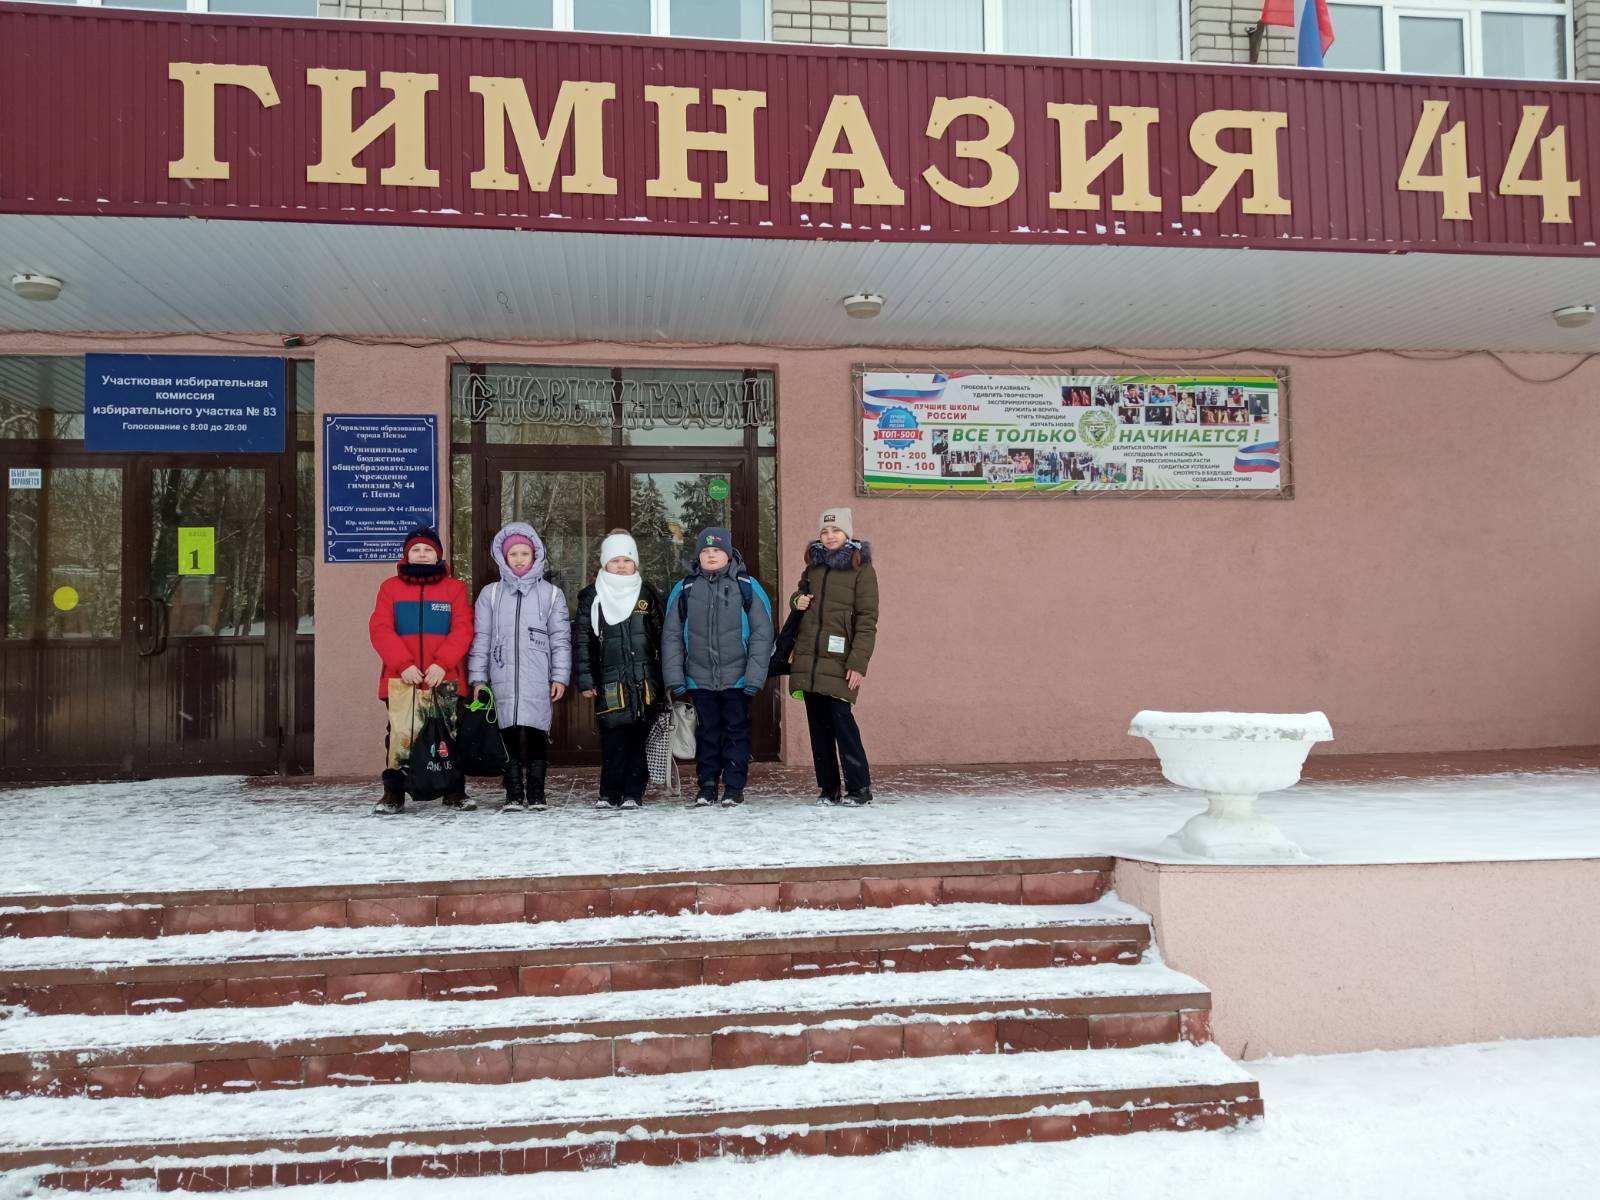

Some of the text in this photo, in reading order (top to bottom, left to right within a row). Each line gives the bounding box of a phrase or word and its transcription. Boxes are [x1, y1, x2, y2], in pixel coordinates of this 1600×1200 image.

[168, 61, 1582, 224] ГИМНАЗИЯ 44
[101, 375, 268, 388] Участковая избирательная
[155, 391, 215, 400] комиссия
[92, 405, 277, 418] избирательного участка № 83
[927, 412, 968, 420] РОССИИ
[122, 422, 181, 431] Голосование
[190, 423, 209, 431] 8:00
[224, 424, 248, 432] 20:00
[335, 424, 379, 432] Управление
[881, 430, 916, 438] ТОП-500
[952, 429, 1077, 443] ВСЕ ТОЛЬКО
[1119, 429, 1249, 443] НАЧИНАЕТСЯ
[344, 446, 418, 455] Муниципальное
[356, 455, 406, 463] бюджетное
[908, 452, 927, 460] 200
[332, 464, 429, 472] общеобразовательное
[877, 461, 902, 470] ТОП
[914, 462, 936, 471] 100
[354, 474, 408, 482] учреждение
[188, 549, 201, 570] 1
